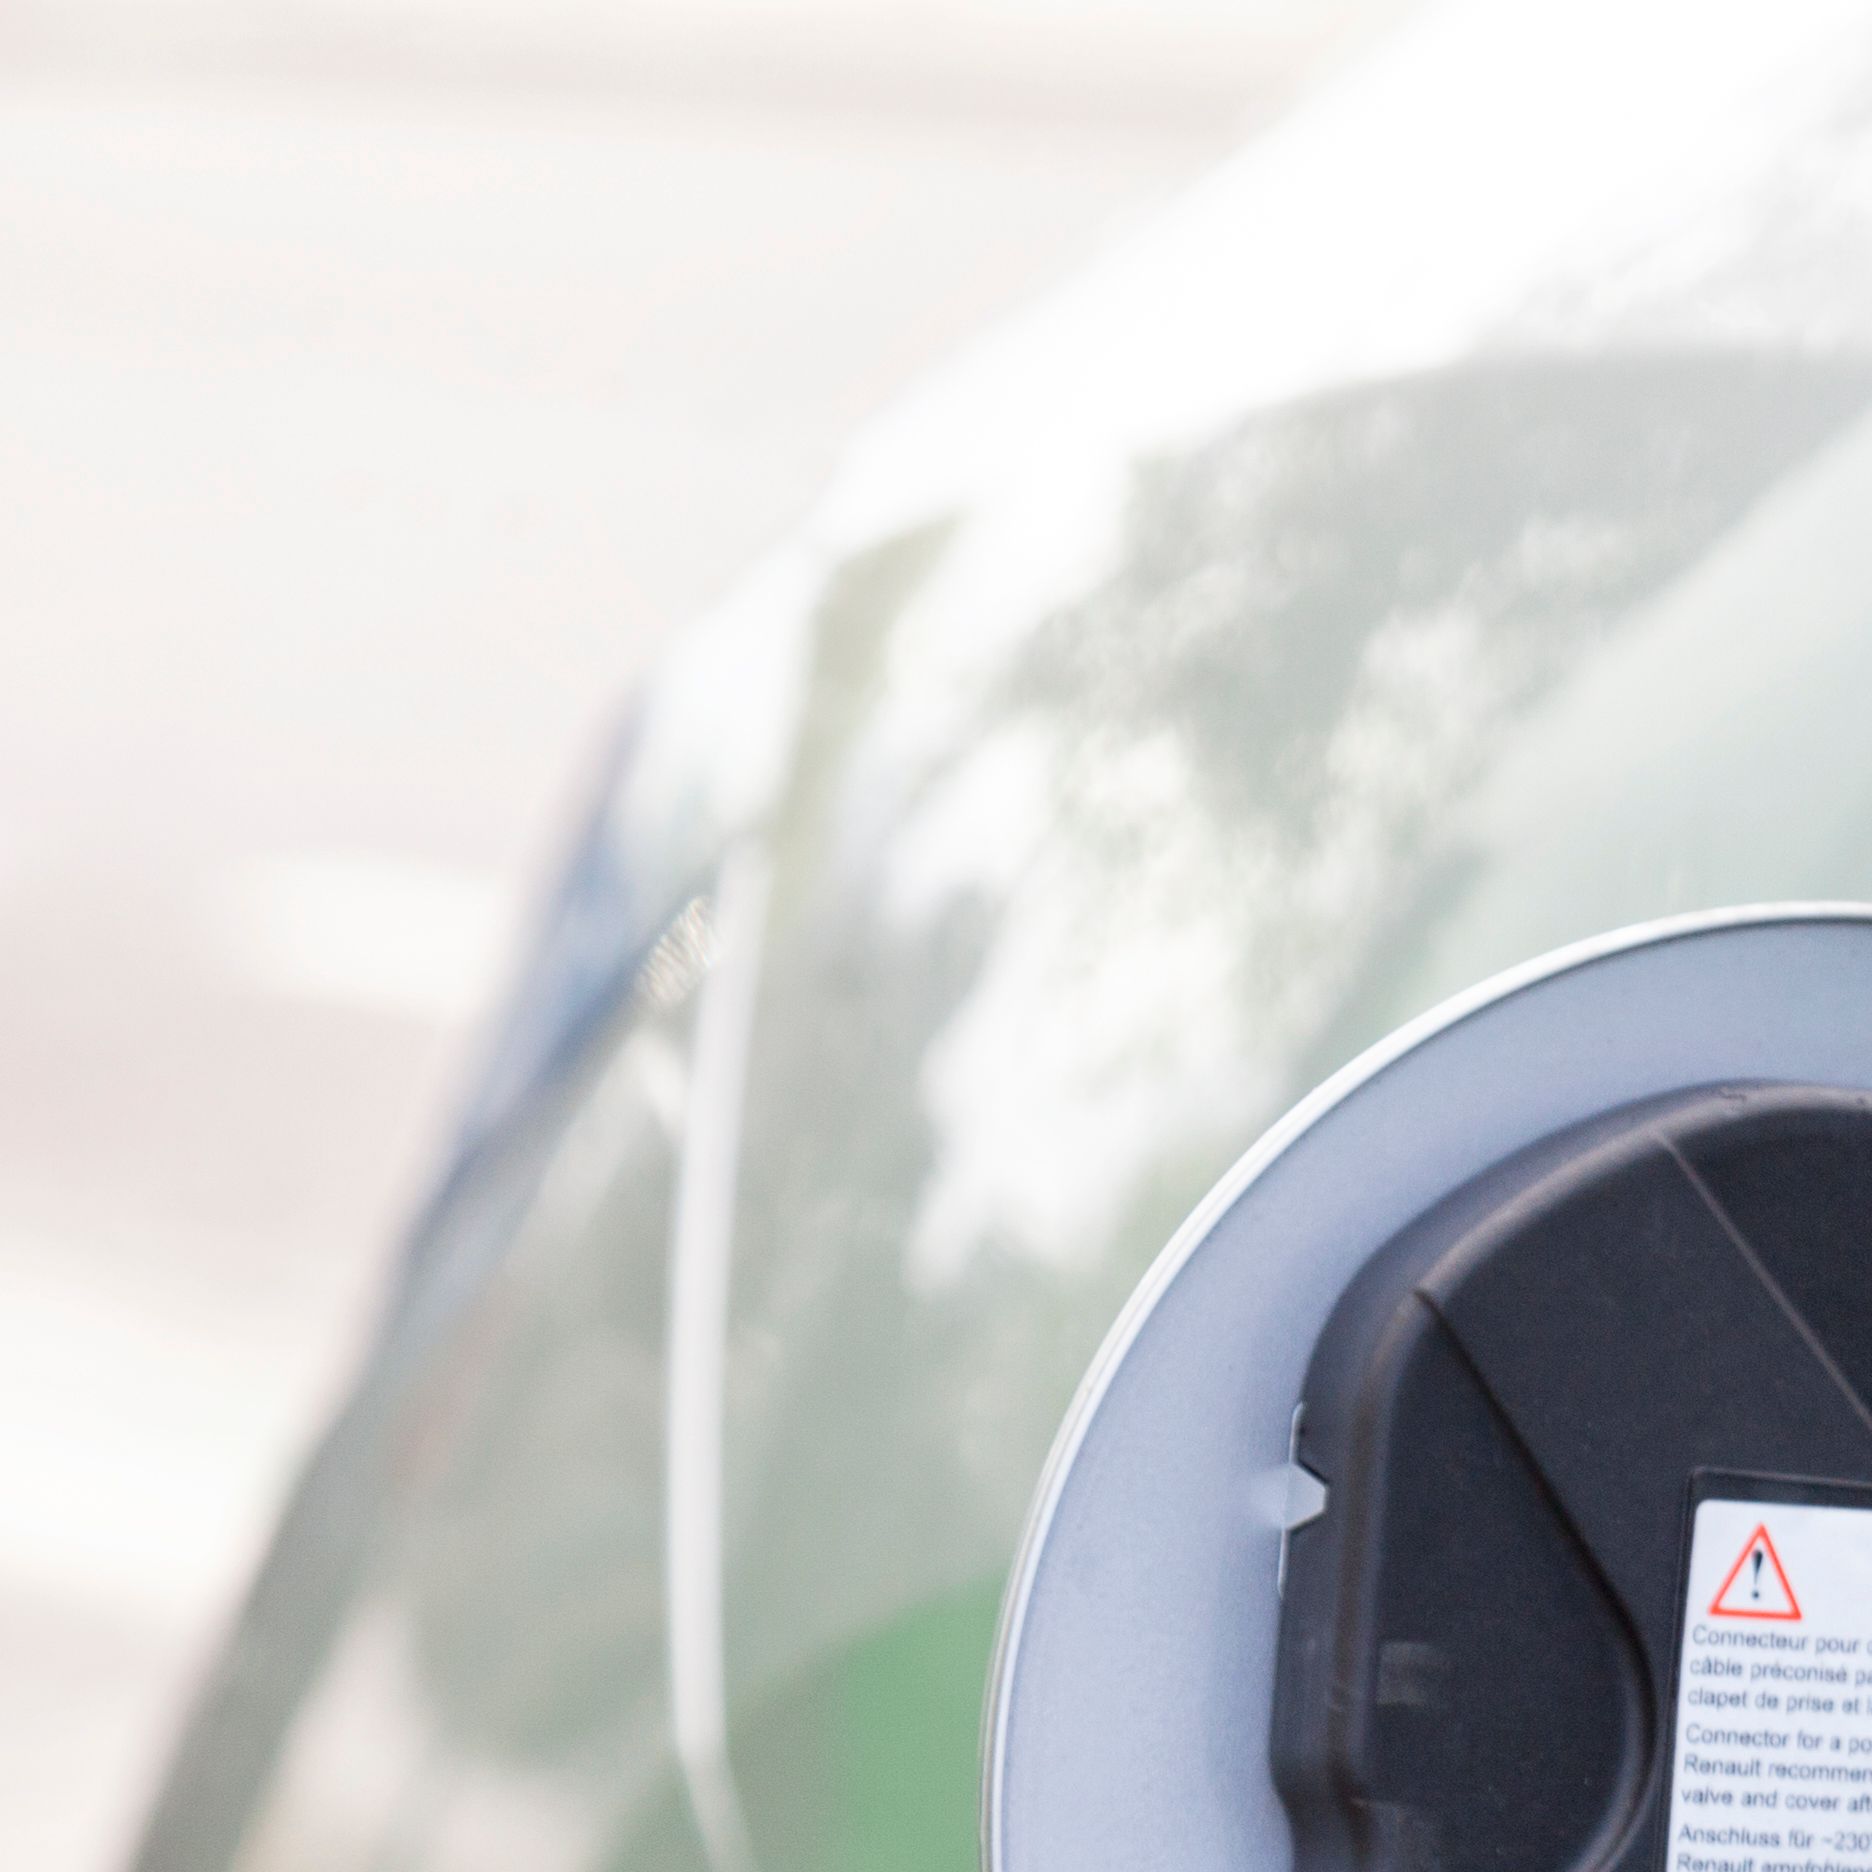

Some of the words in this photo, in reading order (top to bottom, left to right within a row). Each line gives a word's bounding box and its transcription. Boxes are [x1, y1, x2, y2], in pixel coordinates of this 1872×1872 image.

[1692, 1624, 1808, 1651] Connecteur
[1815, 1637, 1859, 1654] pour
[1687, 1687, 1748, 1709] clapet
[1754, 1691, 1779, 1710] de
[1785, 1695, 1834, 1713] prise
[1841, 1697, 1859, 1714] et
[1685, 1723, 1790, 1748] Connector
[1796, 1729, 1823, 1750] for
[1829, 1735, 1842, 1751] a
[1683, 1753, 1761, 1777] Renault
[1681, 1786, 1734, 1806] valve
[1740, 1789, 1778, 1808] and
[1784, 1794, 1840, 1811] cover
[1678, 1823, 1781, 1848] Anschluss
